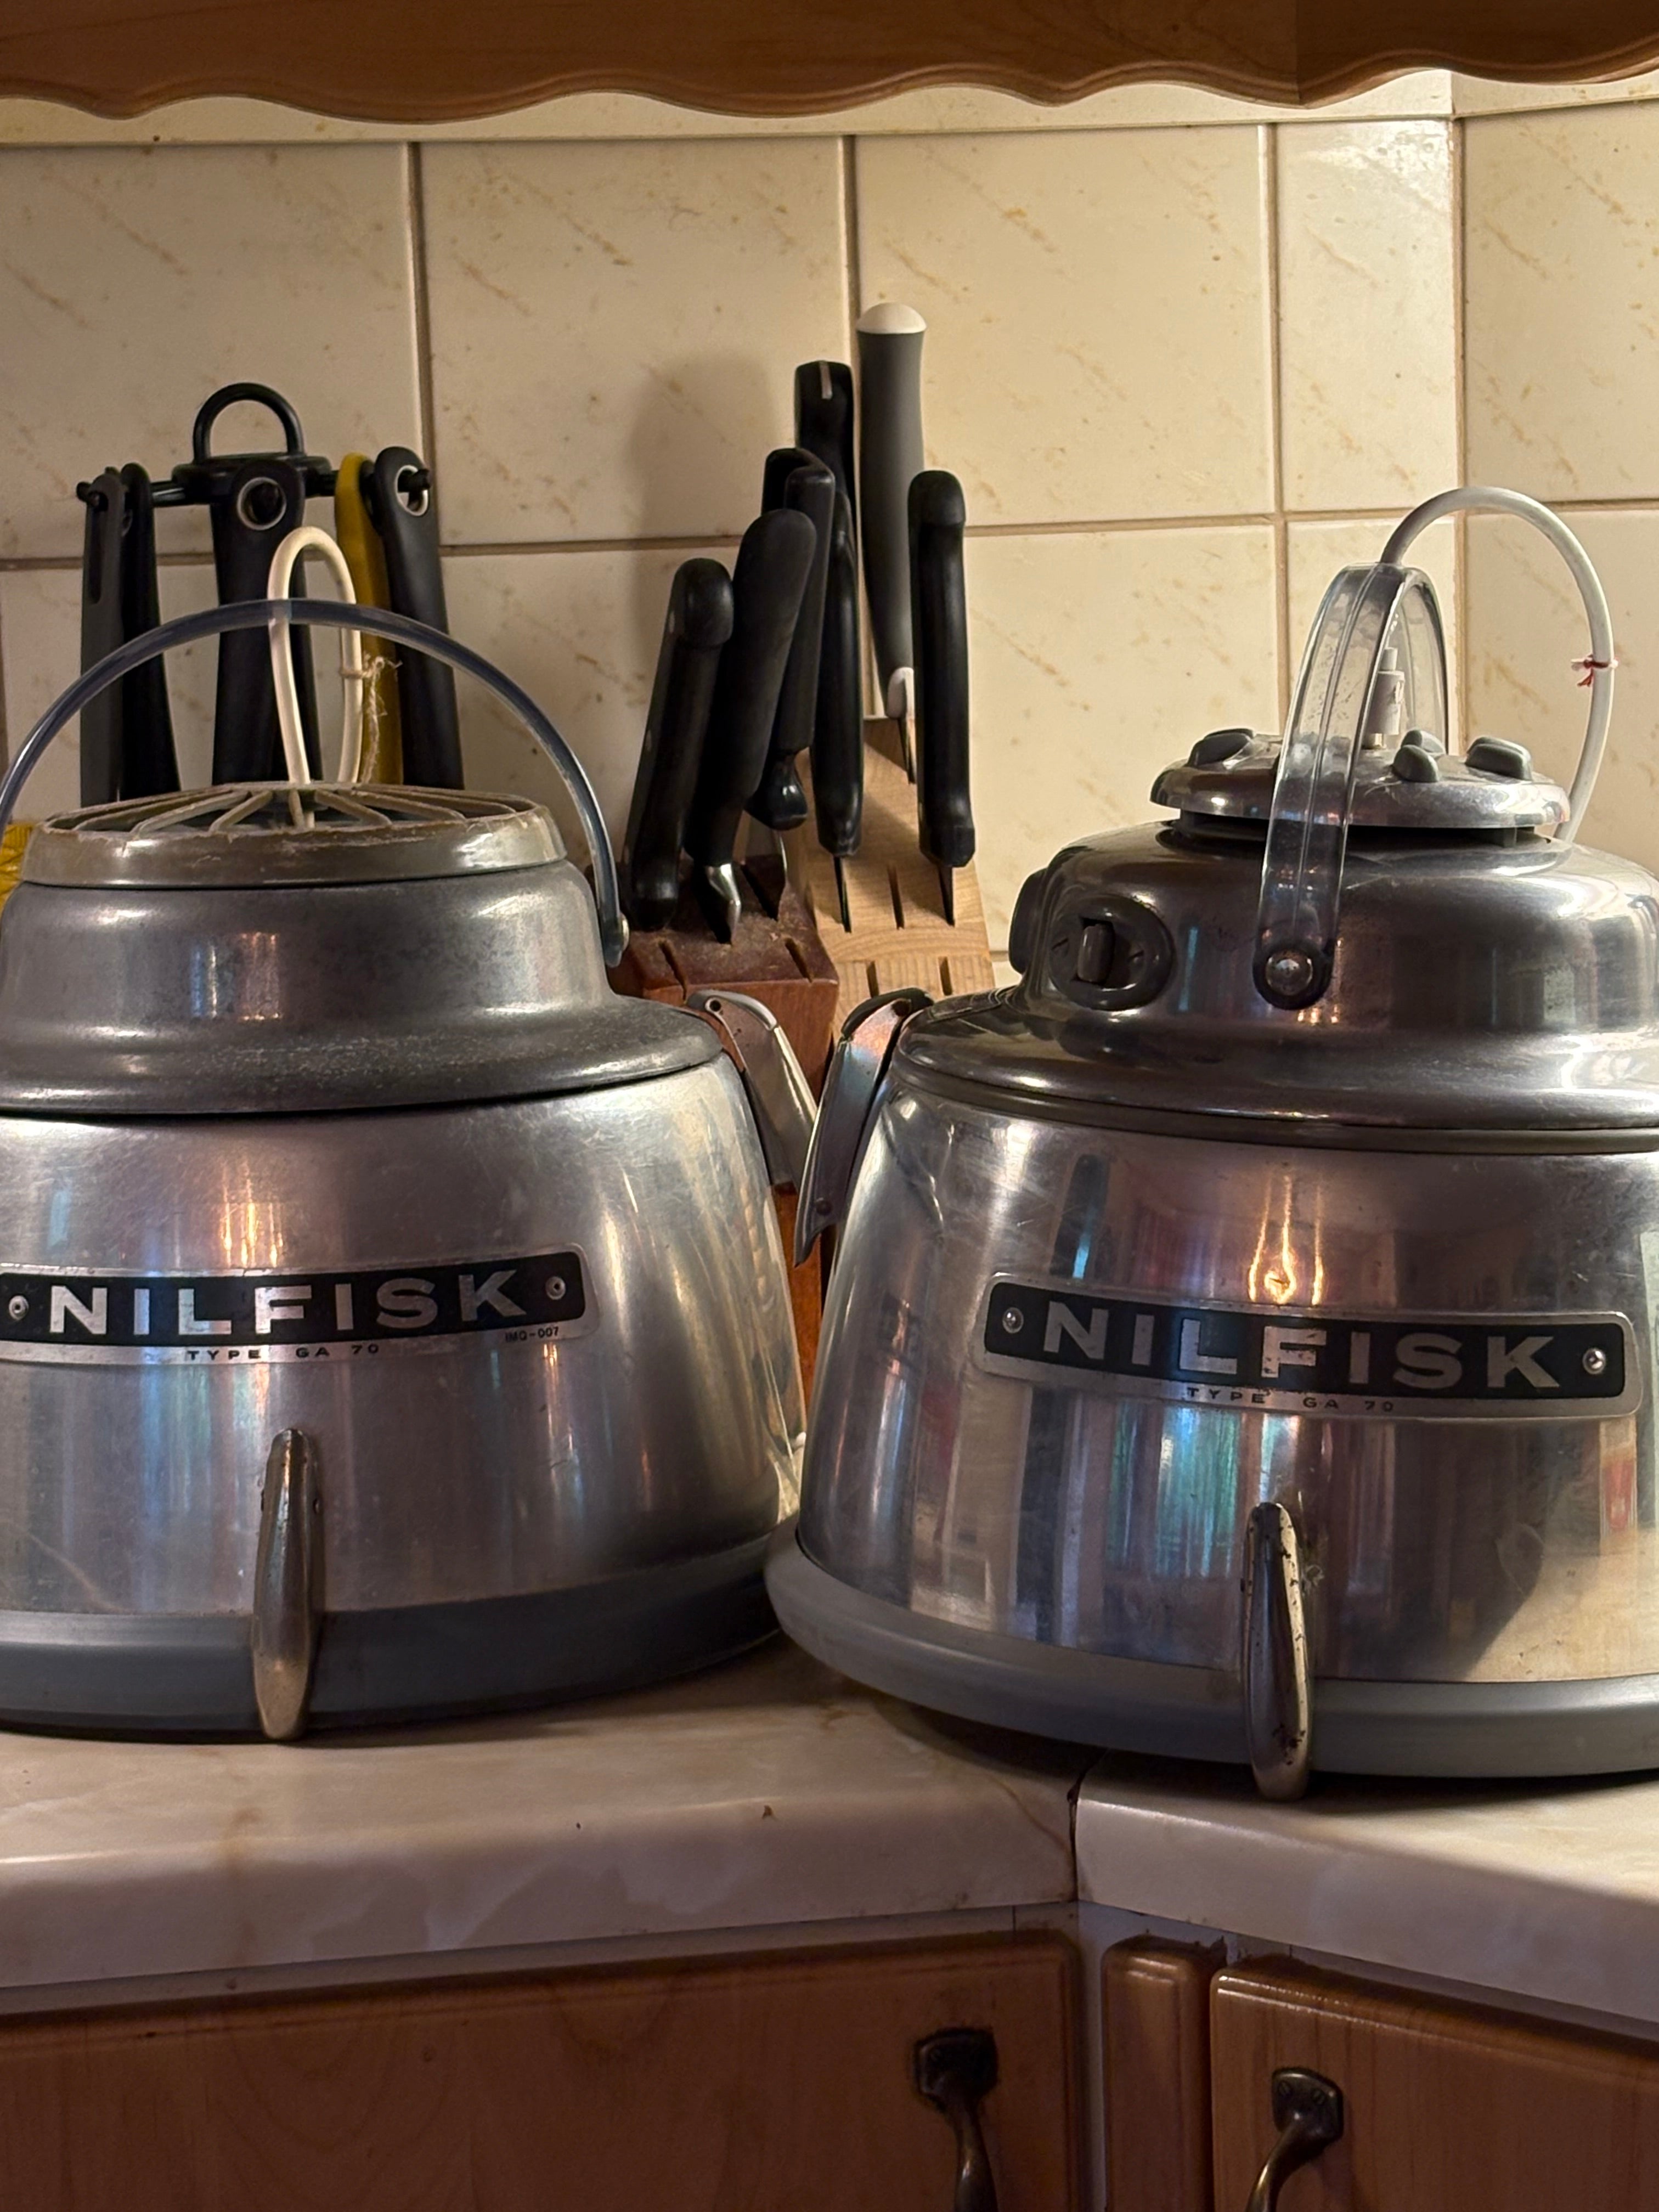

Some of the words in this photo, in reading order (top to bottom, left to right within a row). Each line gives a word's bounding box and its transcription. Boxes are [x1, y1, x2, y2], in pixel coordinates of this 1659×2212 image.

[49, 1270, 526, 1335] NILFISK
[187, 1349, 262, 1361] TYPE
[295, 1347, 329, 1358] GA
[351, 1345, 380, 1355] 70
[1043, 1301, 1561, 1389] NILFISK
[1187, 1387, 1266, 1403] TYPE
[1302, 1396, 1339, 1409] GA
[1364, 1401, 1395, 1413] 70
